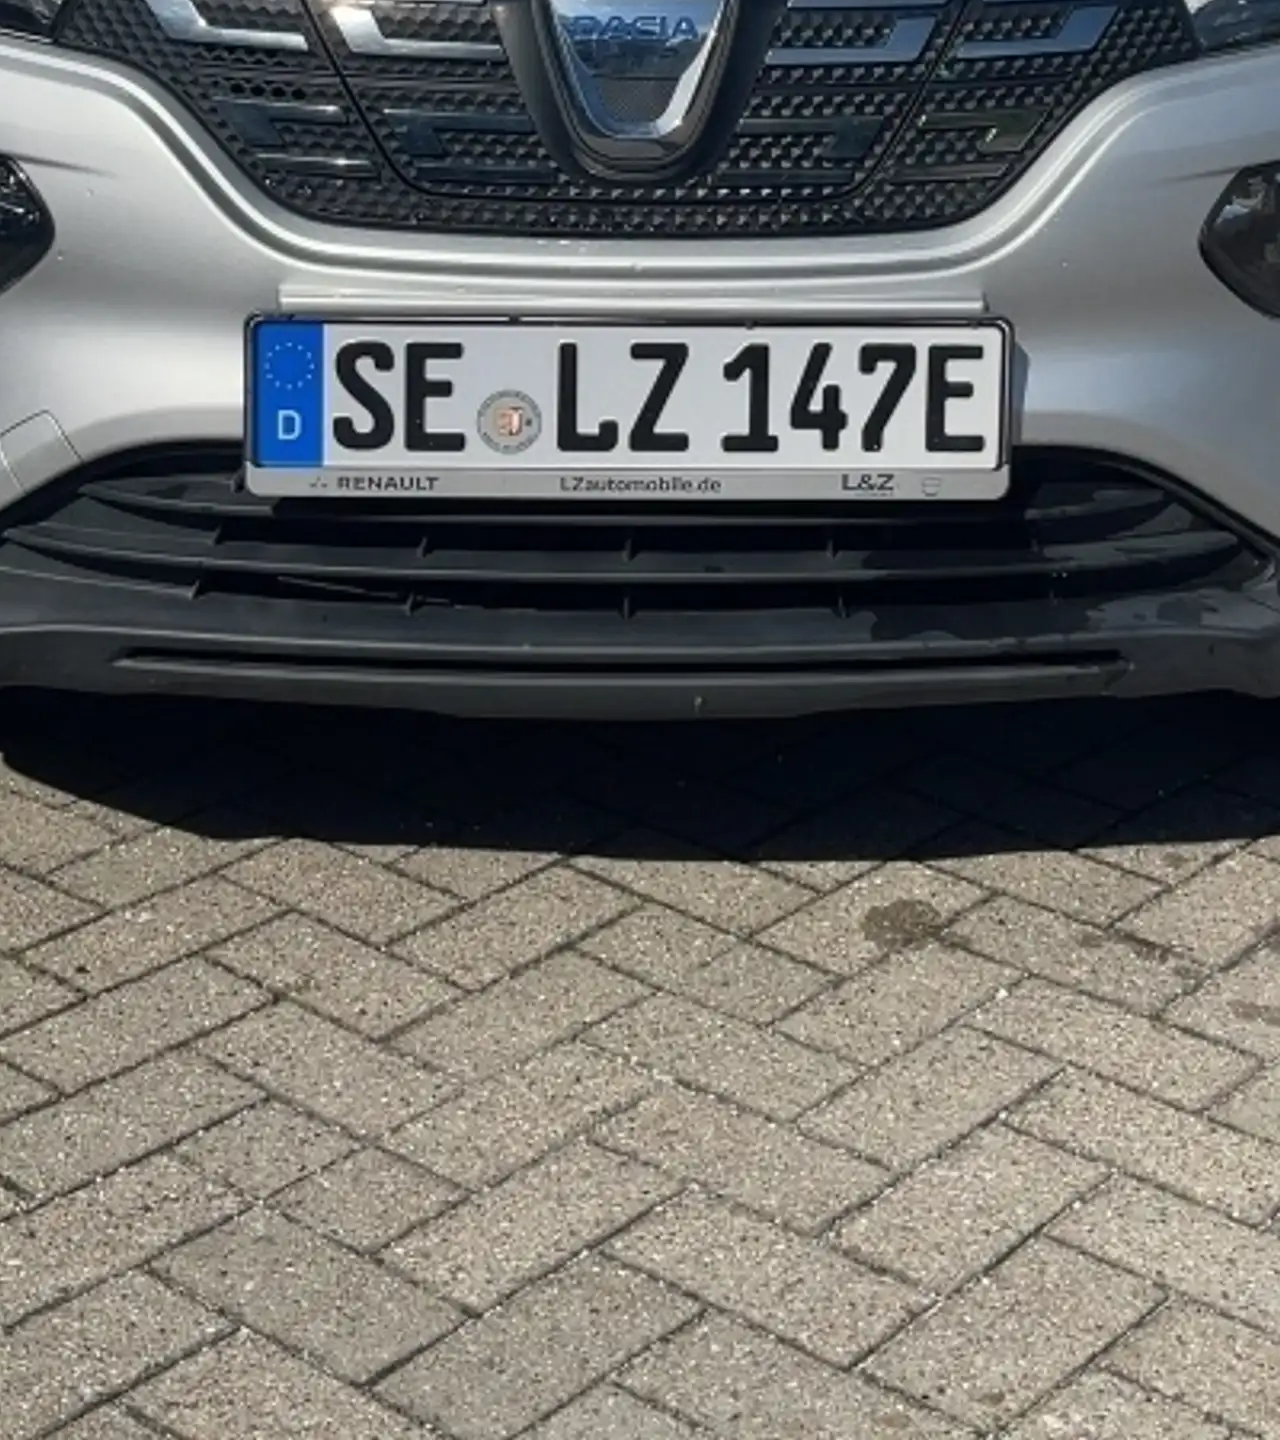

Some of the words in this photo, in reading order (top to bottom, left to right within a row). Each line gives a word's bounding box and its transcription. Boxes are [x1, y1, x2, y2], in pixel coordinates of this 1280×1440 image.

[570, 15, 700, 41] DACIA
[277, 409, 302, 440] D
[332, 341, 466, 452] SE
[556, 342, 690, 452] LZ
[721, 342, 986, 452] 147E
[336, 476, 440, 491] RENAULT
[559, 476, 722, 493] LZautomobile.de
[841, 474, 896, 491] L&Z
